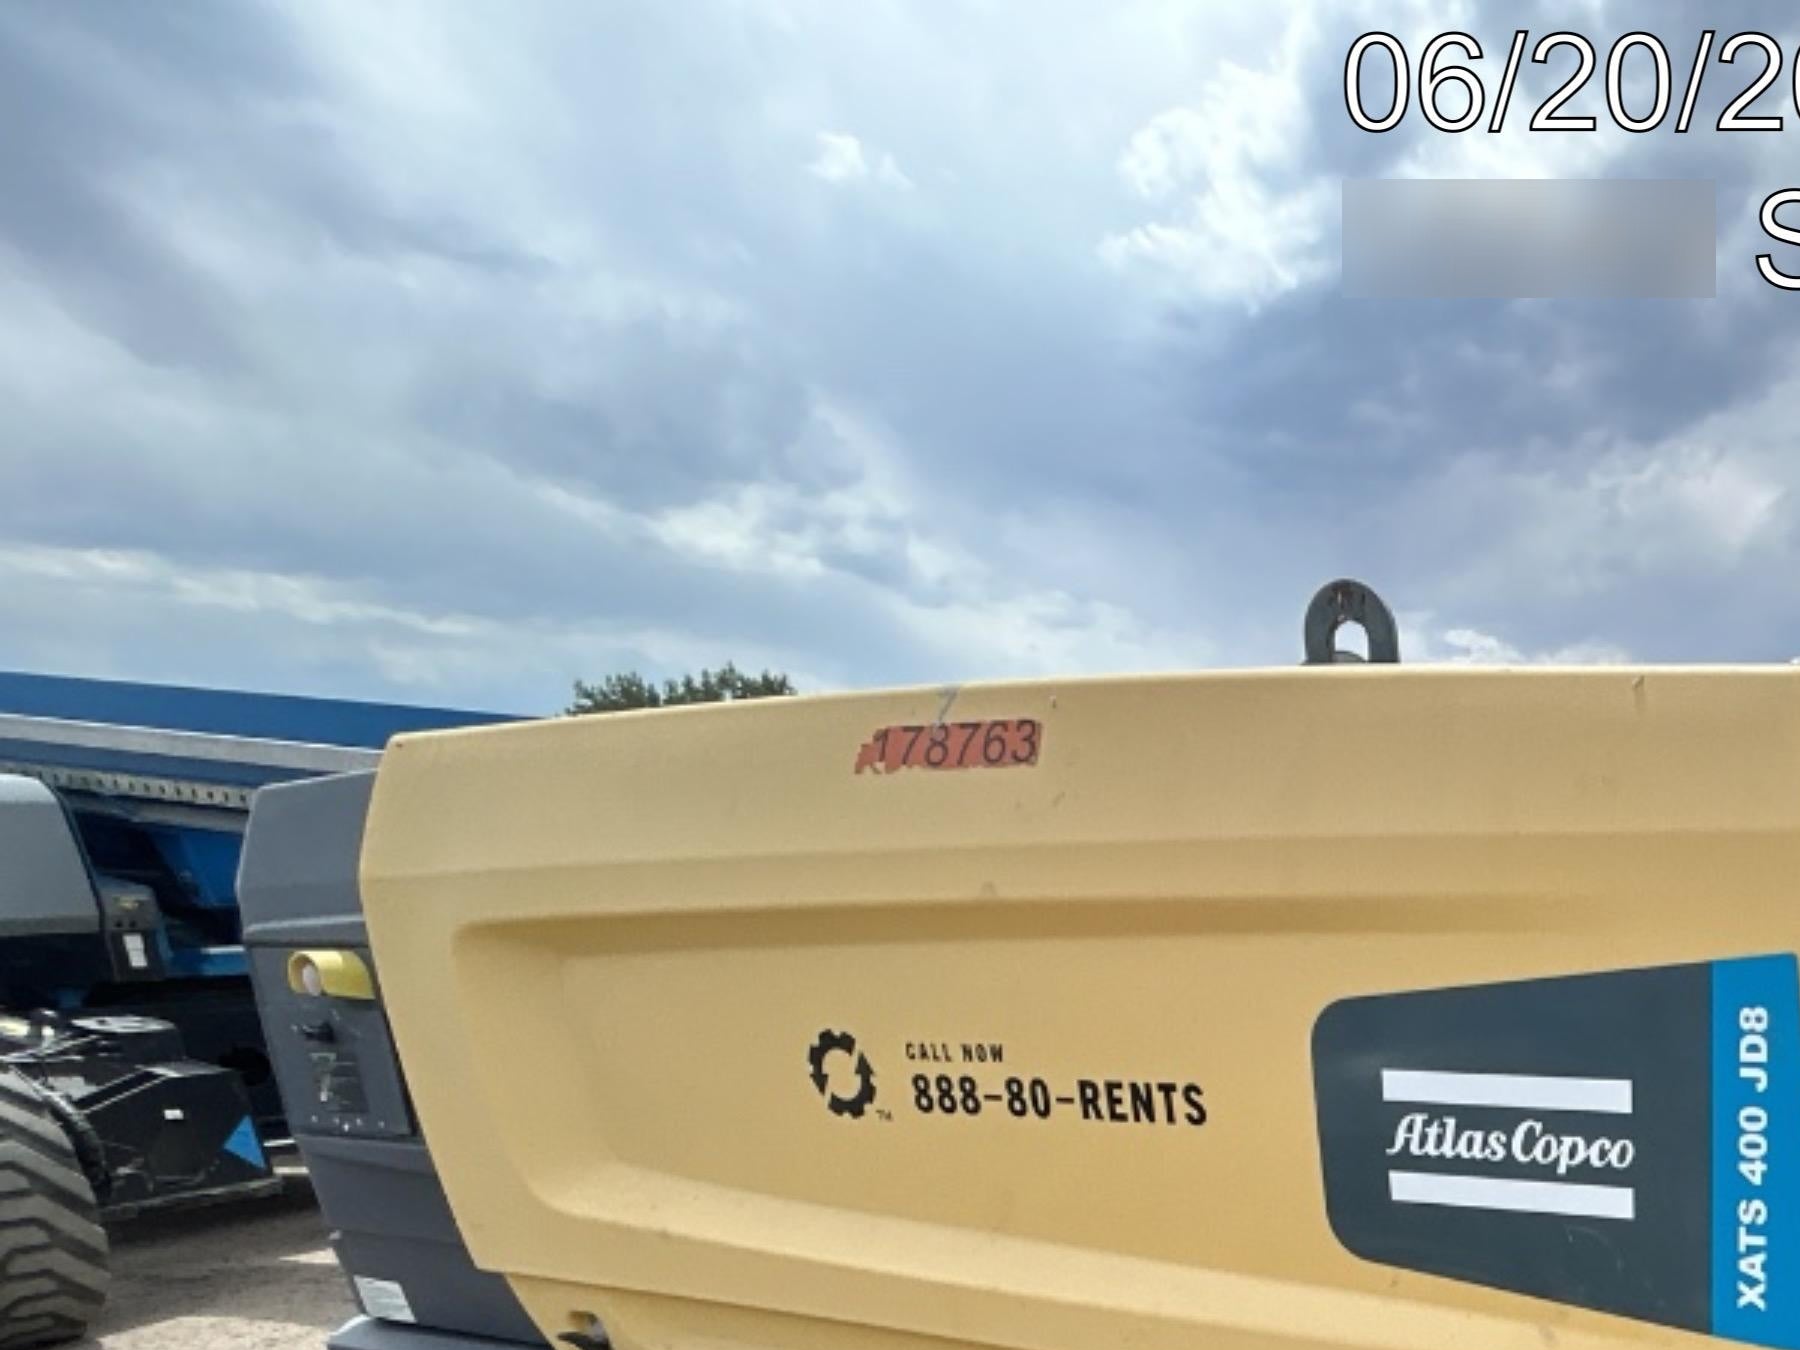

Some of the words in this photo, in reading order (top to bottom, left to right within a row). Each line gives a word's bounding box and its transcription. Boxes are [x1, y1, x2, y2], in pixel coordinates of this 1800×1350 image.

[871, 718, 1039, 769] 178763
[905, 1042, 953, 1062] CALL
[961, 1044, 1004, 1063] NOW
[1738, 1005, 1770, 1093] JD8
[911, 1073, 1208, 1127] 888-80-RENTS
[1385, 1111, 1507, 1162] Atlas
[1510, 1119, 1635, 1175] Copco
[1736, 1105, 1769, 1187] 400
[1736, 1198, 1769, 1311] XATS
